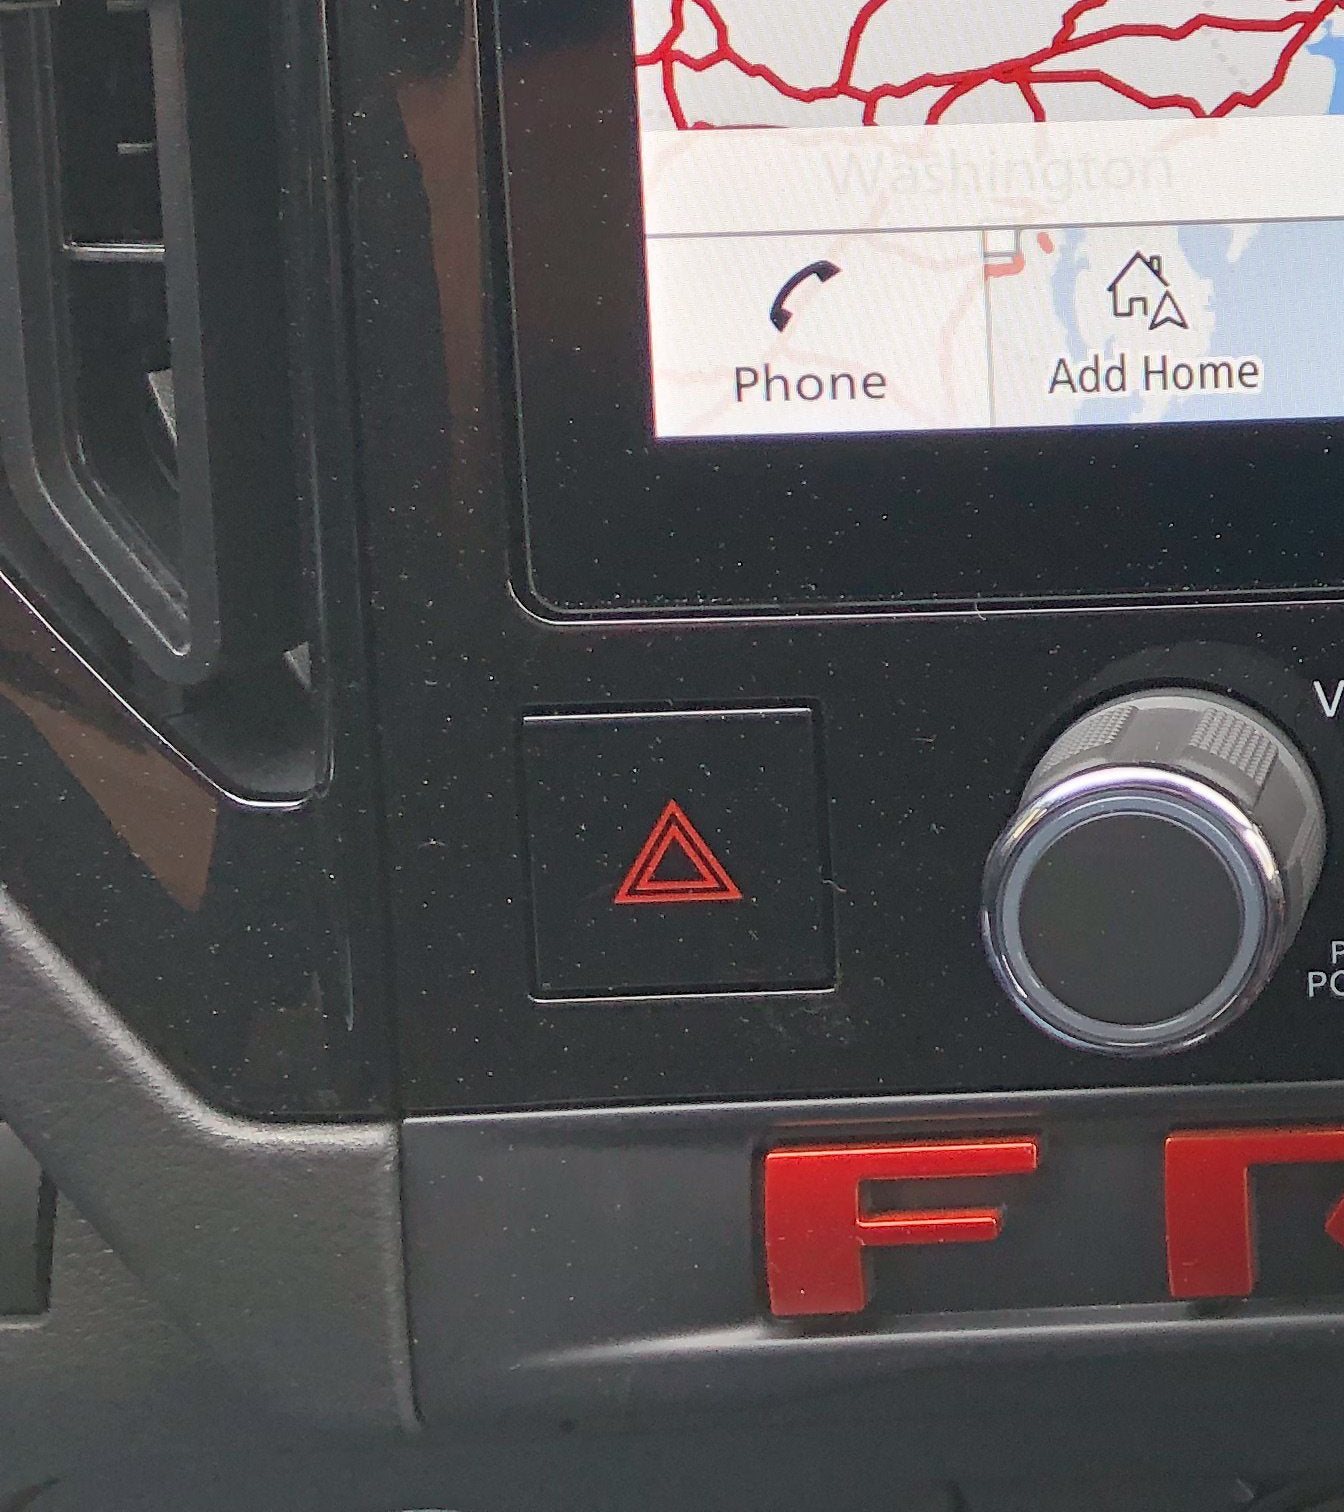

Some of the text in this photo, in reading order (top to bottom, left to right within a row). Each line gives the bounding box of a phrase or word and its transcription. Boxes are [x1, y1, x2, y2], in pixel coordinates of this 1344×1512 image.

[821, 147, 1174, 204] Washington
[735, 364, 888, 403] Phone
[1048, 352, 1260, 395] Add Home
